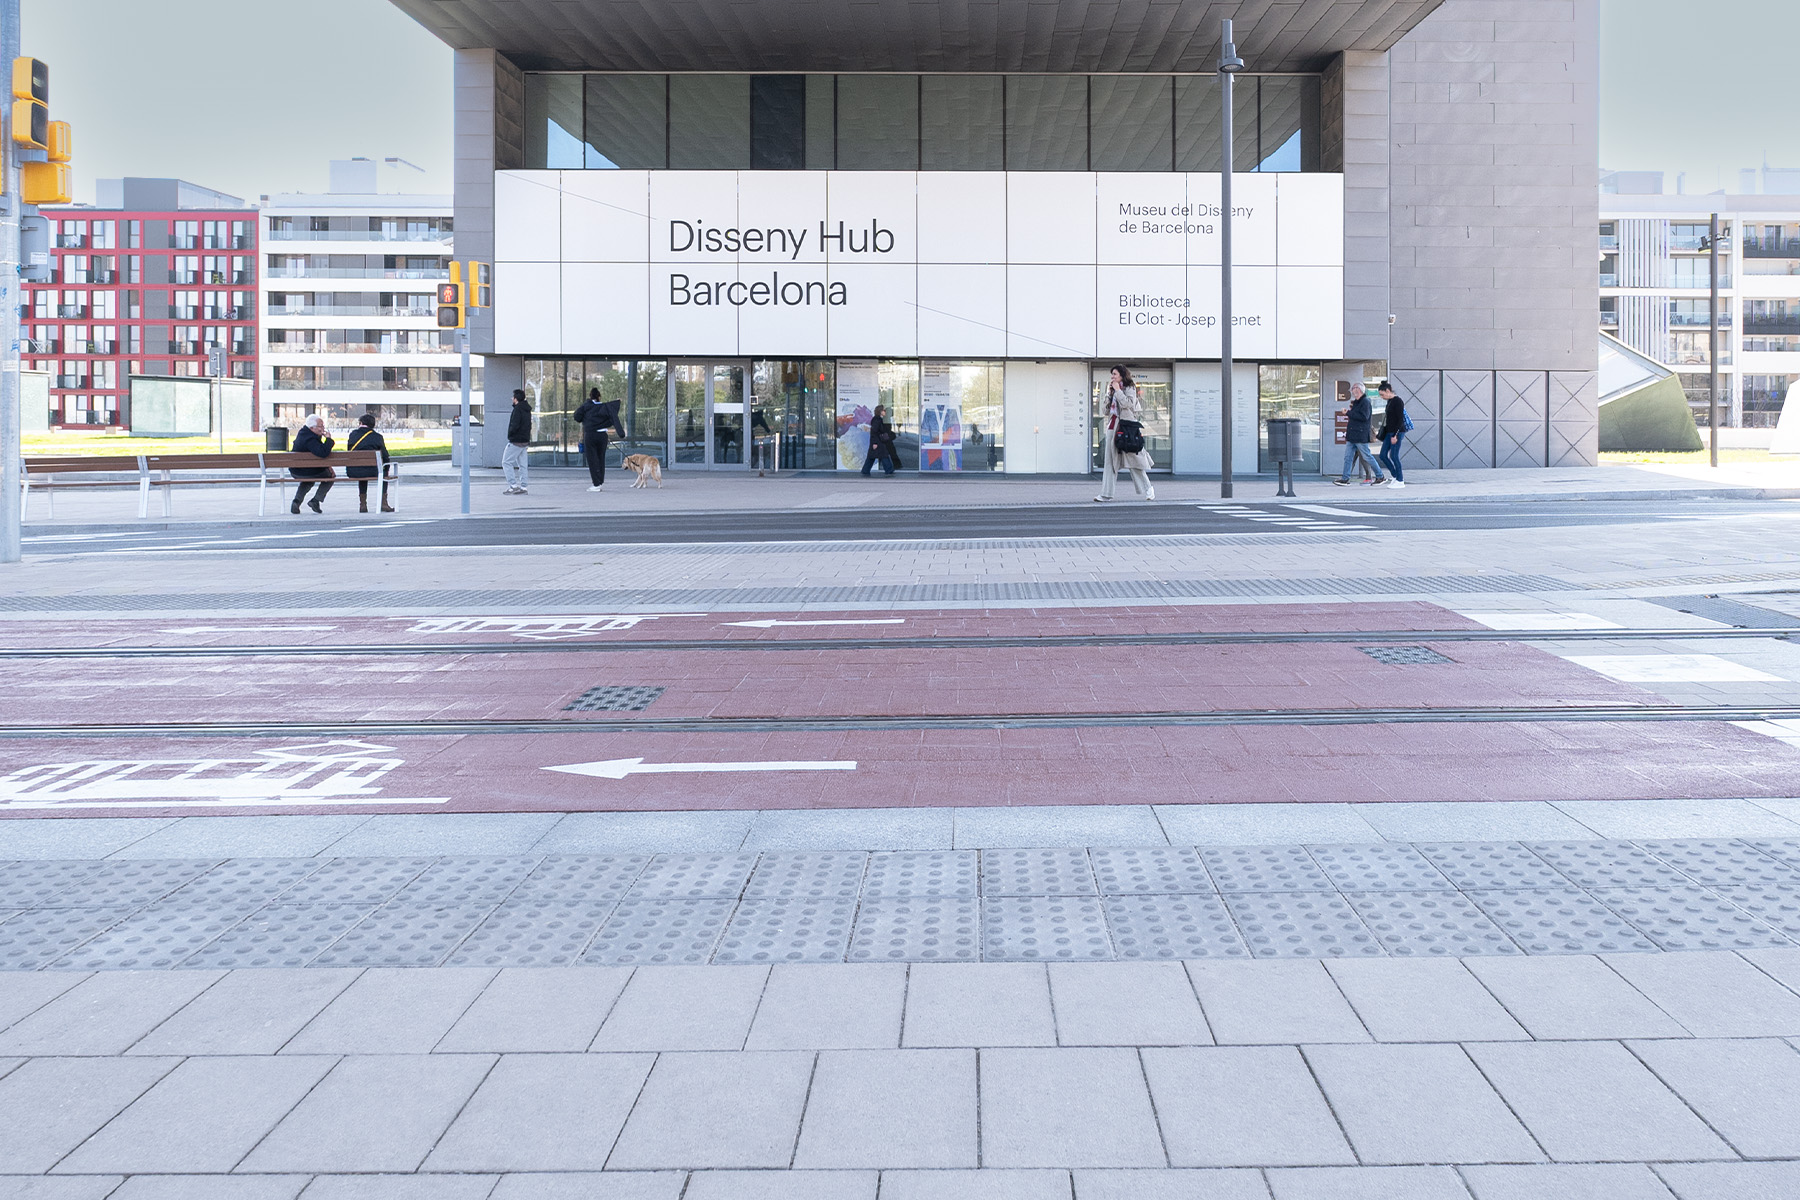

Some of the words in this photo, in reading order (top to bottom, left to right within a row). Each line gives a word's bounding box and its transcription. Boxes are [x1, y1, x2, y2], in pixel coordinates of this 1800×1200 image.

[1119, 203, 1166, 216] Museu
[1171, 203, 1193, 216] del
[1198, 204, 1254, 219] Diseny
[1119, 220, 1137, 233] de
[1142, 221, 1214, 234] Barcelona
[670, 219, 808, 260] Disseny
[820, 218, 895, 253] Hub
[670, 271, 847, 306] Barcelona
[1119, 294, 1190, 308] Biblioteca
[1119, 312, 1131, 325] El
[1135, 312, 1165, 325] Clot
[1175, 313, 1216, 328] Josep
[1229, 315, 1262, 326] enet
